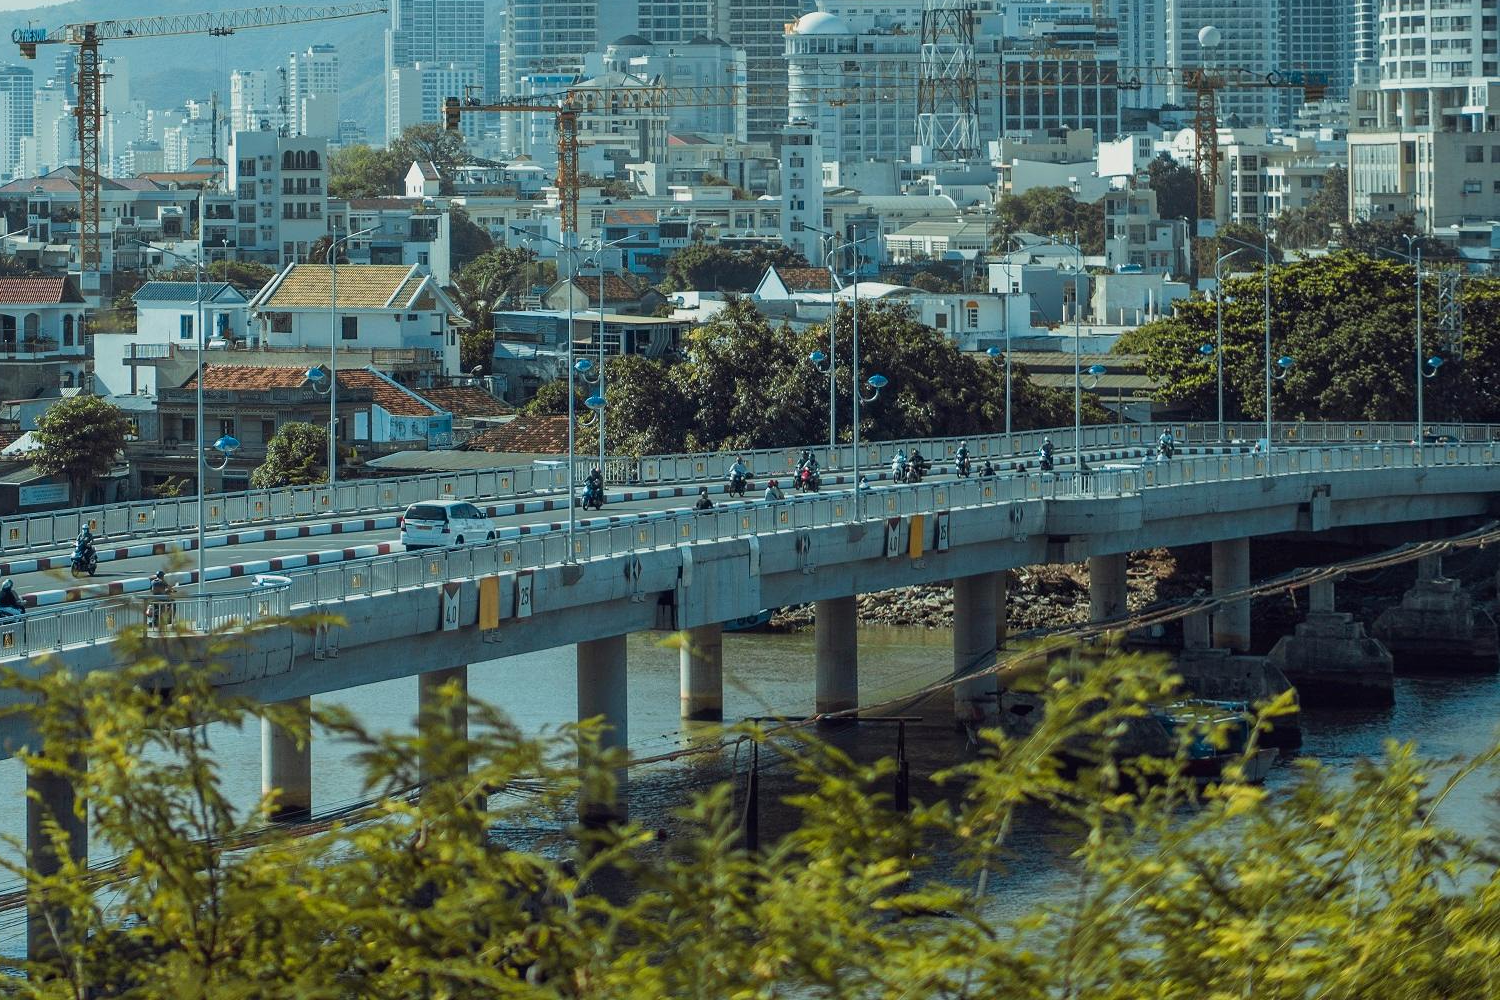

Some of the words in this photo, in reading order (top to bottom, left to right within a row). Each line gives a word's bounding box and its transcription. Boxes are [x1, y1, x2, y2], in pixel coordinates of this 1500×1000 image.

[940, 524, 947, 540] 25
[521, 586, 529, 606] 25
[446, 605, 457, 625] 4.0
